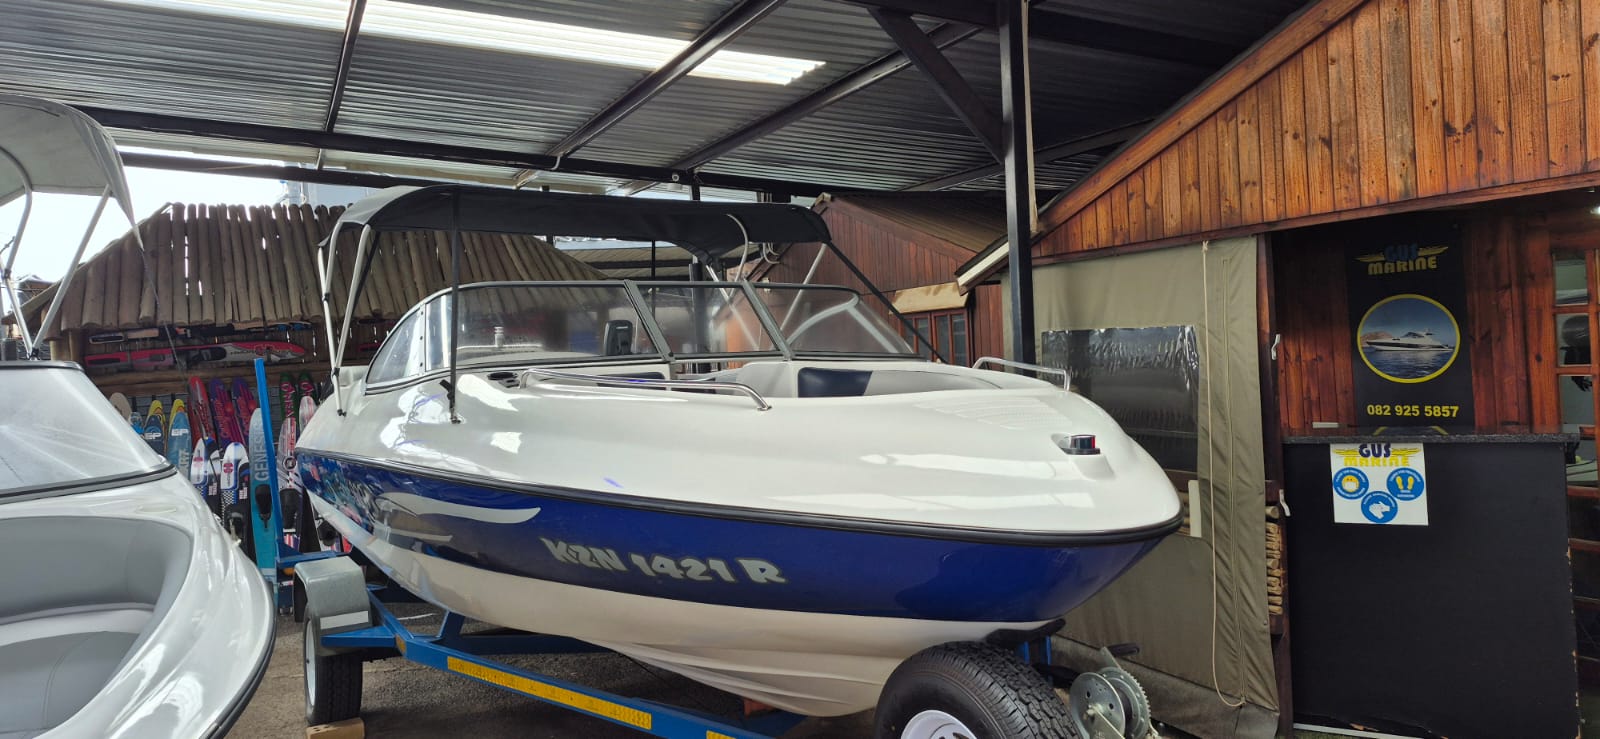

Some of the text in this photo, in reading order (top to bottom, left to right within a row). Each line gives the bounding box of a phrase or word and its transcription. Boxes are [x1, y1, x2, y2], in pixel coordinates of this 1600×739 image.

[1384, 244, 1419, 261] GUS
[1367, 256, 1438, 275] MARINE
[1366, 404, 1459, 417] 082 925 5857
[1358, 442, 1392, 458] GUS
[1343, 456, 1410, 467] MARINE
[629, 553, 736, 582] 1421
[736, 557, 787, 583] R
